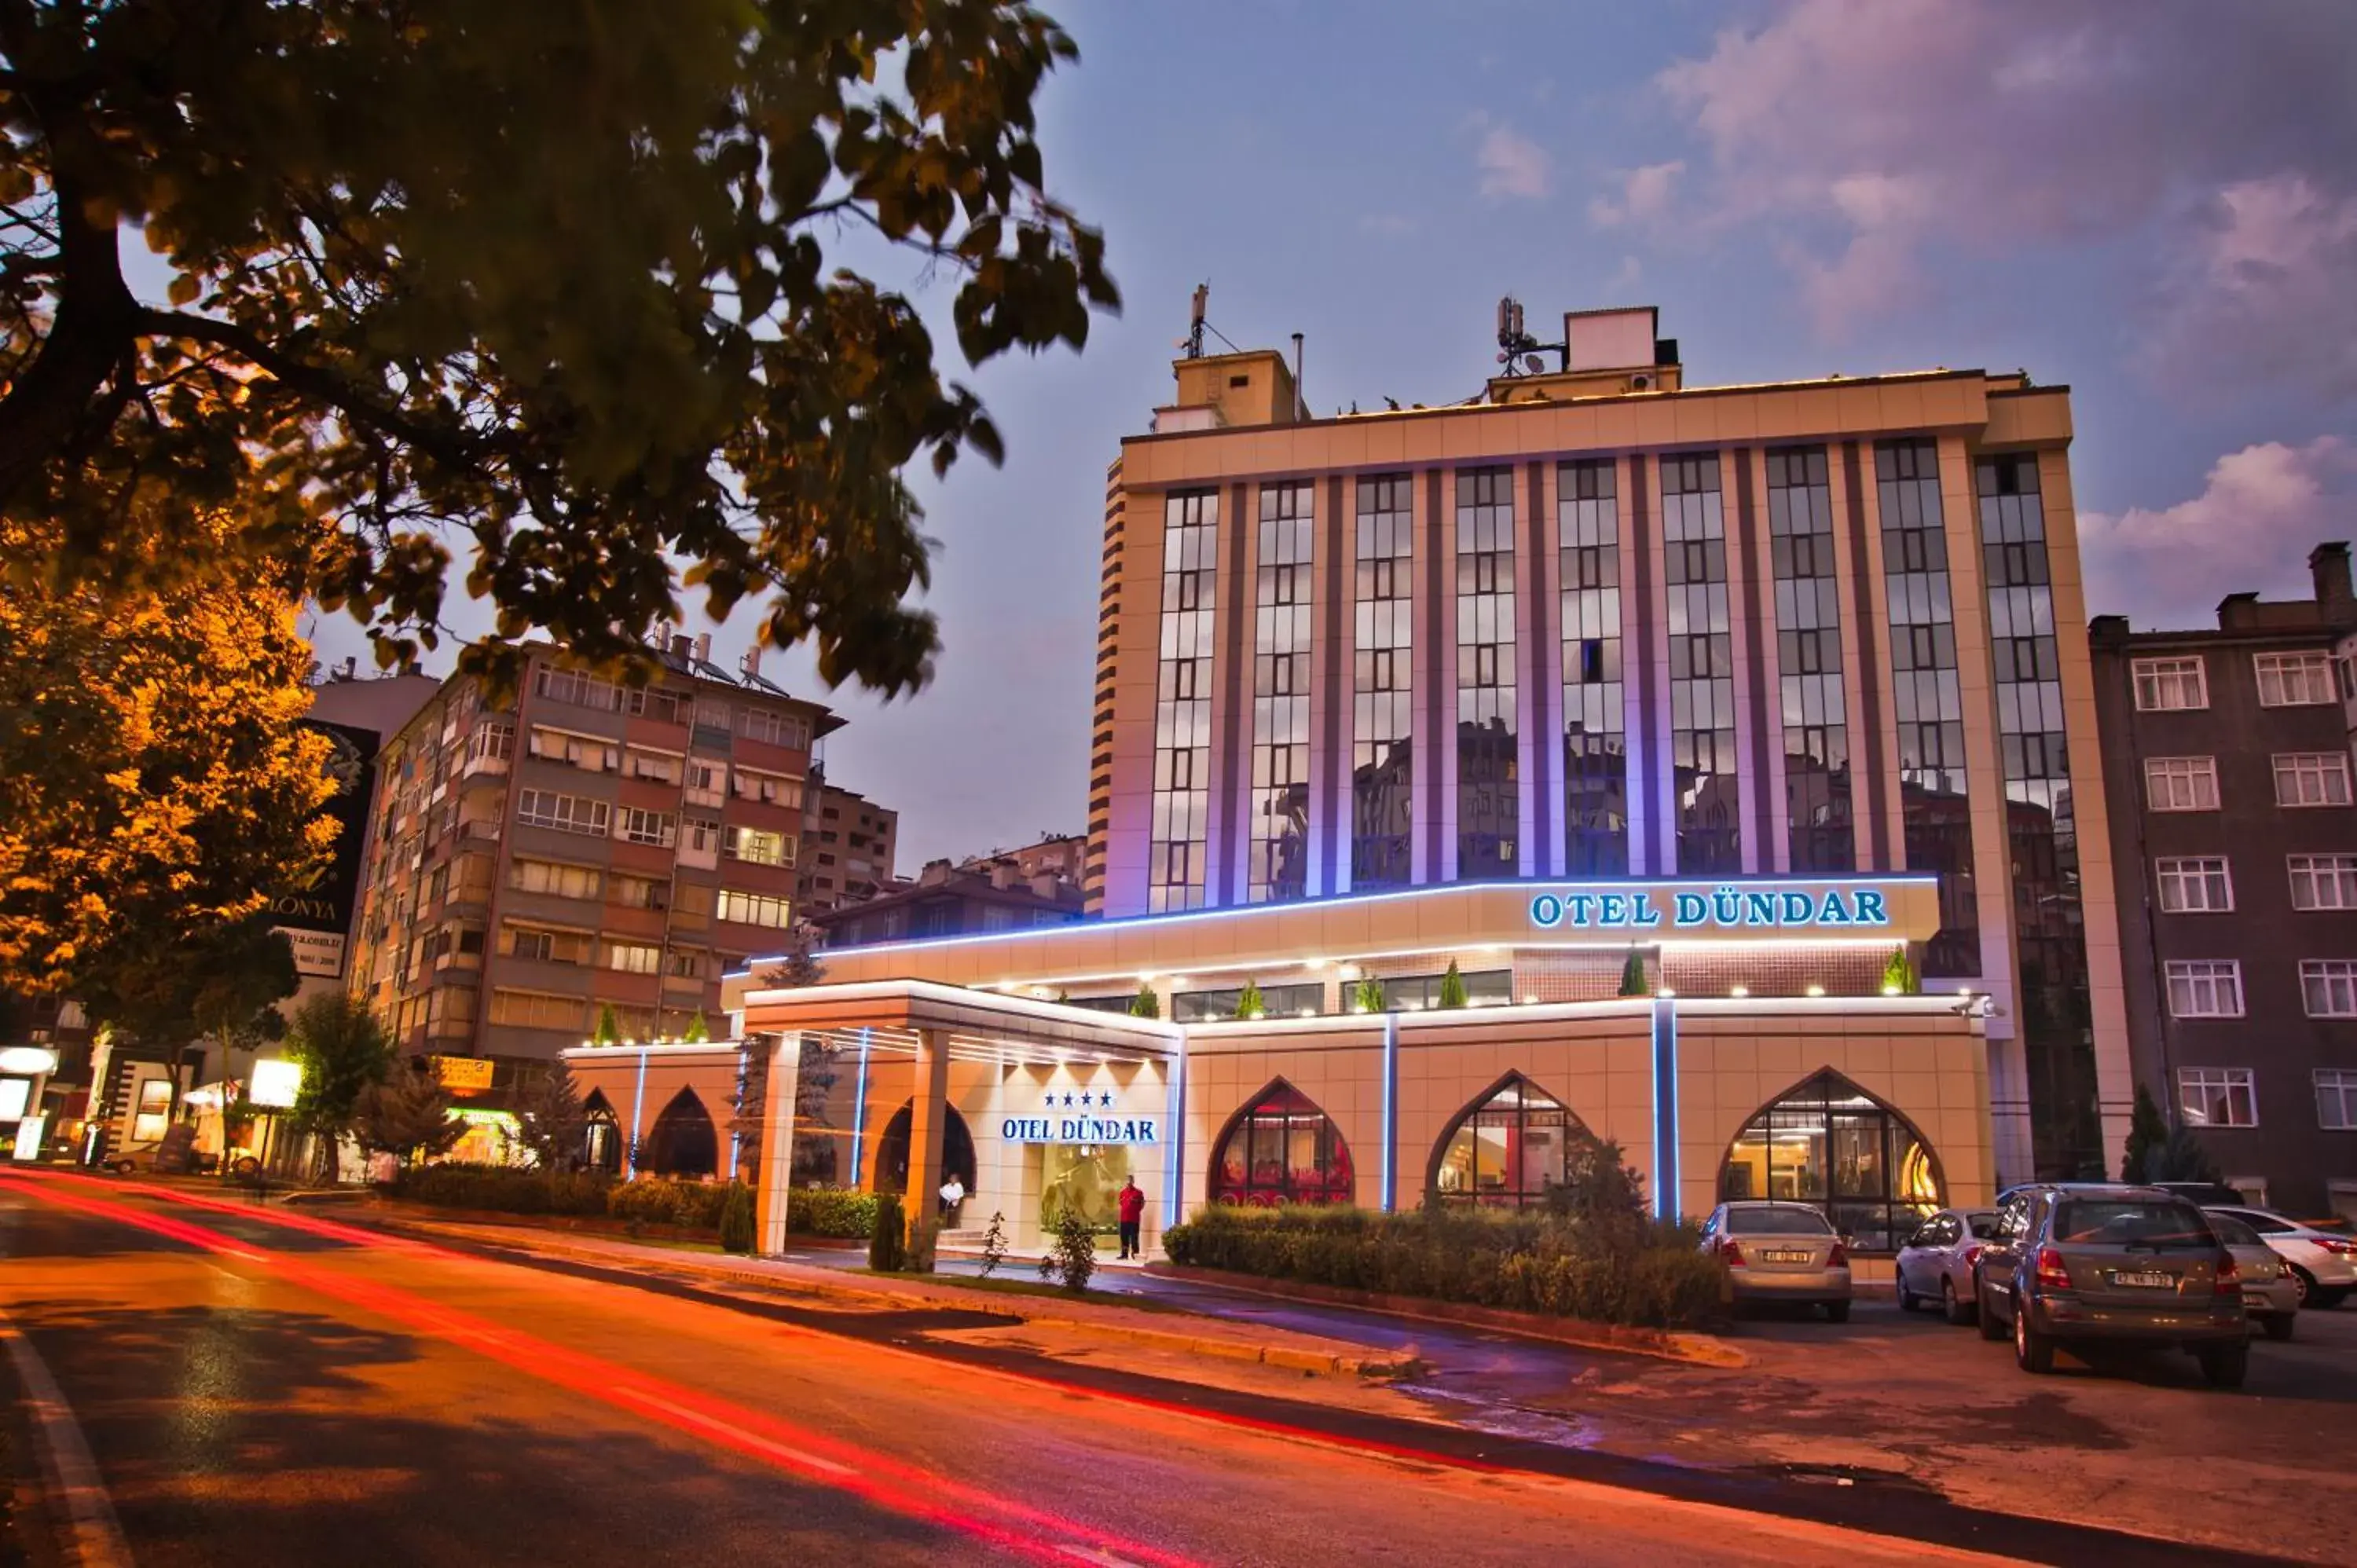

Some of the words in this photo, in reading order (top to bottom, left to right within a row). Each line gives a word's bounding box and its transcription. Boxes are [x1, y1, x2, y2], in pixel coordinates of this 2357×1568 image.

[1531, 892, 1660, 925] OTEL
[1675, 886, 1887, 925] DÜNDAR
[1002, 1119, 1054, 1140] OTEL
[1061, 1113, 1156, 1141] DÜNDAR
